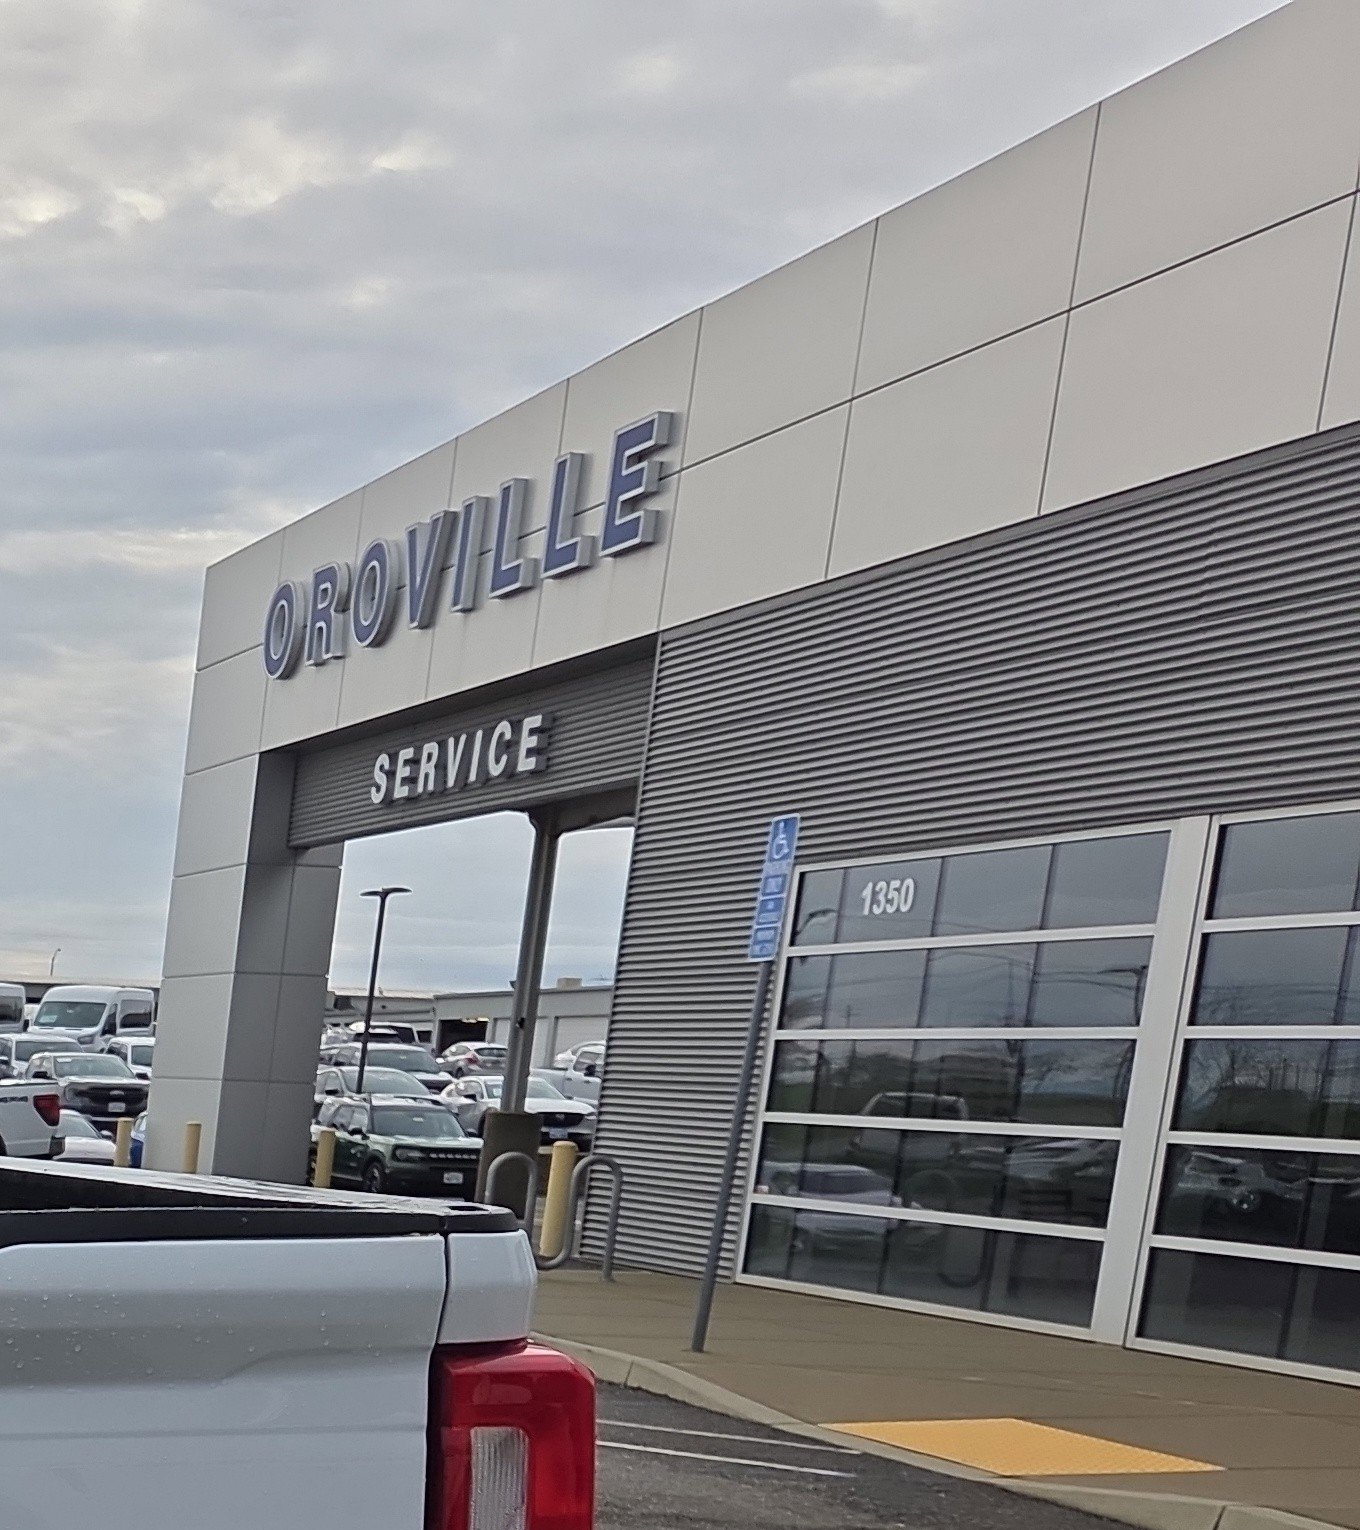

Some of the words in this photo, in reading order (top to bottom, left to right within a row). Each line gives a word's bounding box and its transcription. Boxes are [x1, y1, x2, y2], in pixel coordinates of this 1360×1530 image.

[263, 411, 678, 680] OROVILLE
[371, 713, 544, 804] SERVICE
[861, 878, 915, 916] 1350
